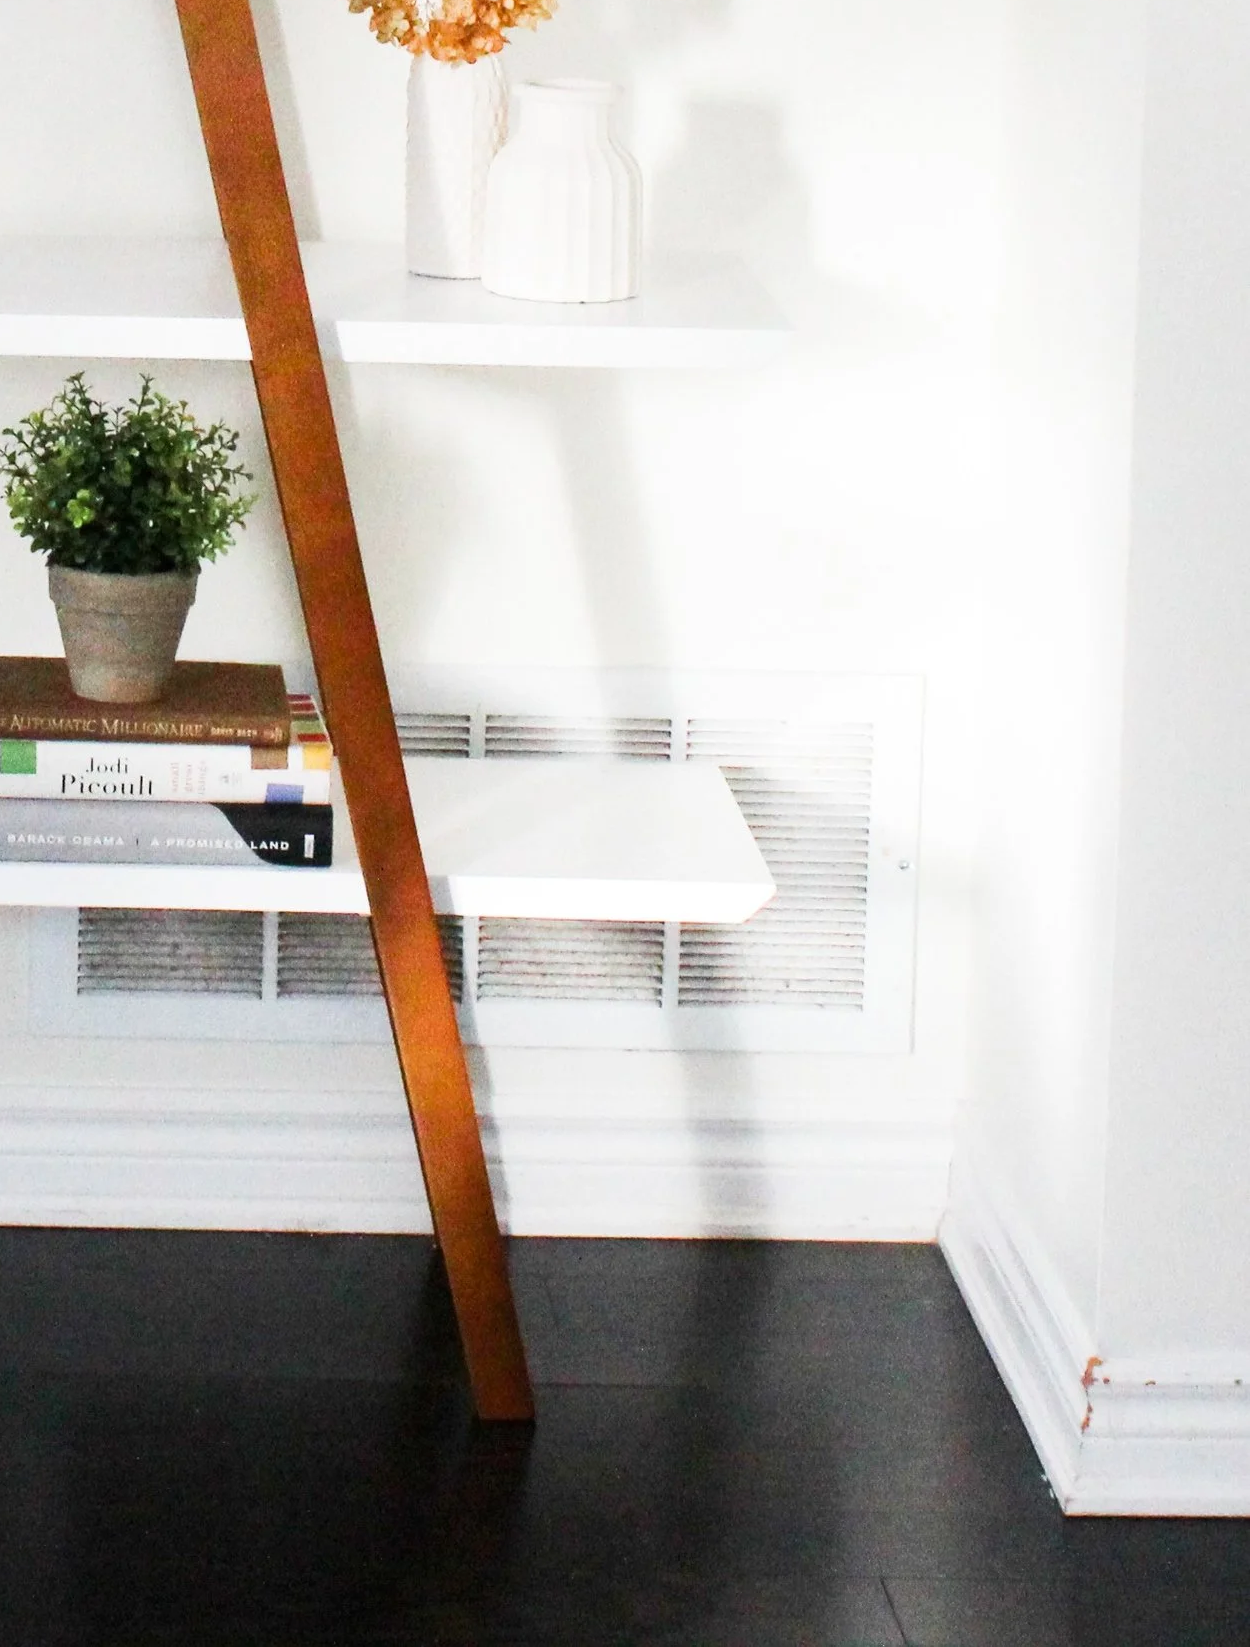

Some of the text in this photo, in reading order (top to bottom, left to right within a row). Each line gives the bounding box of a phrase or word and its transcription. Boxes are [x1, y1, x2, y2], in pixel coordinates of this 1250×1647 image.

[10, 714, 97, 733] AUTOMATIC
[100, 718, 203, 738] MILLIONAIRE
[85, 757, 128, 774] Jodi
[61, 774, 153, 795] Picoult
[7, 834, 290, 851] BARACK OBAMA A PROMISED LAND
